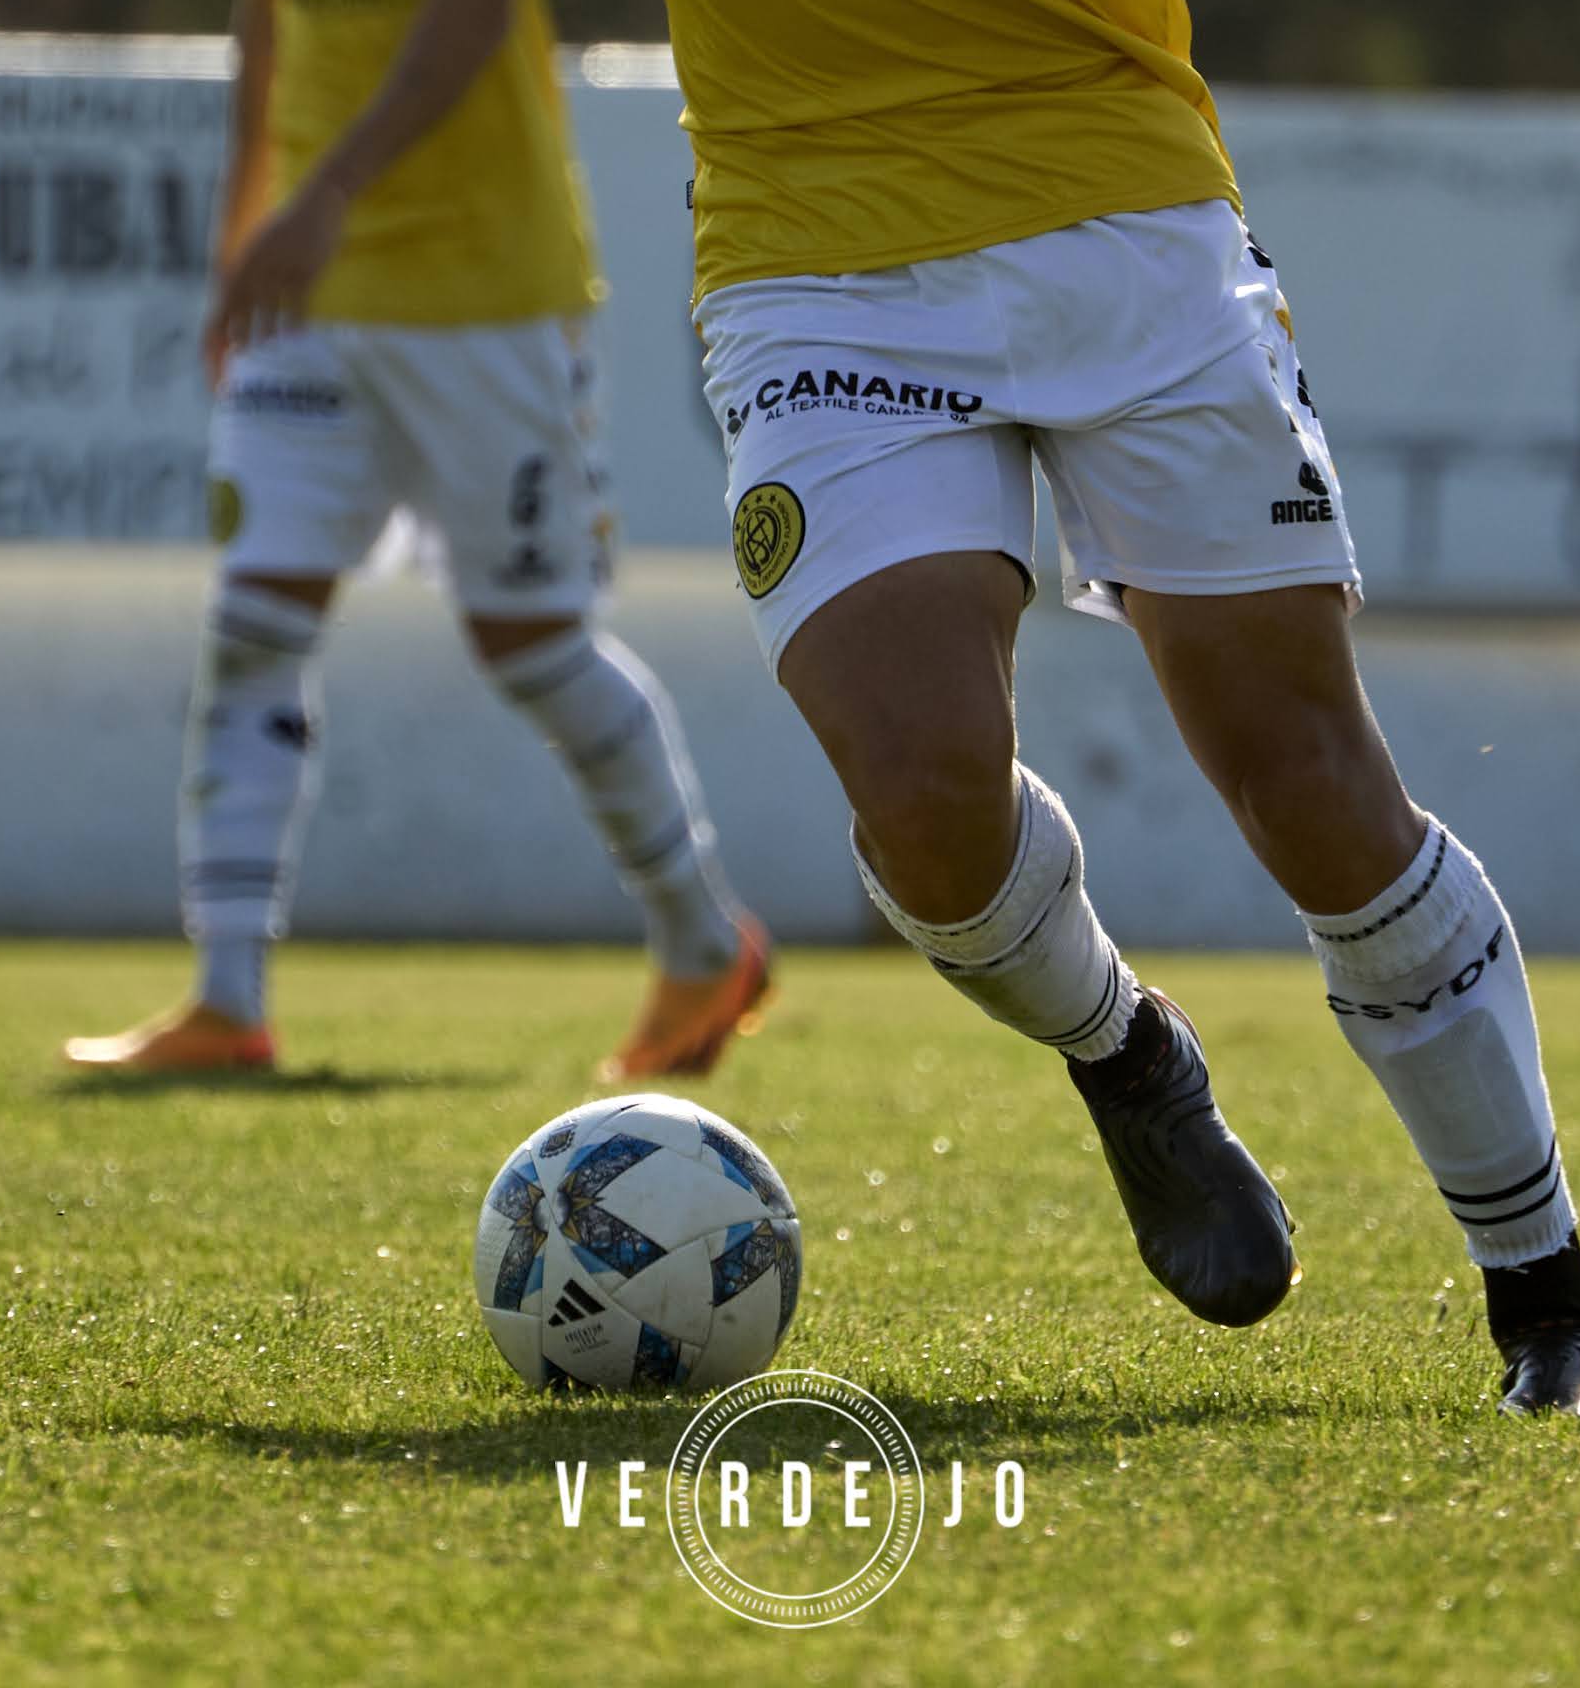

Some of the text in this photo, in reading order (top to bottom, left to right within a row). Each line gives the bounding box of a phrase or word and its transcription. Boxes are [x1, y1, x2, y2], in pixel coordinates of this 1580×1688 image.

[755, 370, 983, 414] CANARIO
[764, 408, 784, 424] AL
[789, 398, 859, 413] TEXTILE
[1271, 498, 1335, 525] ANGE
